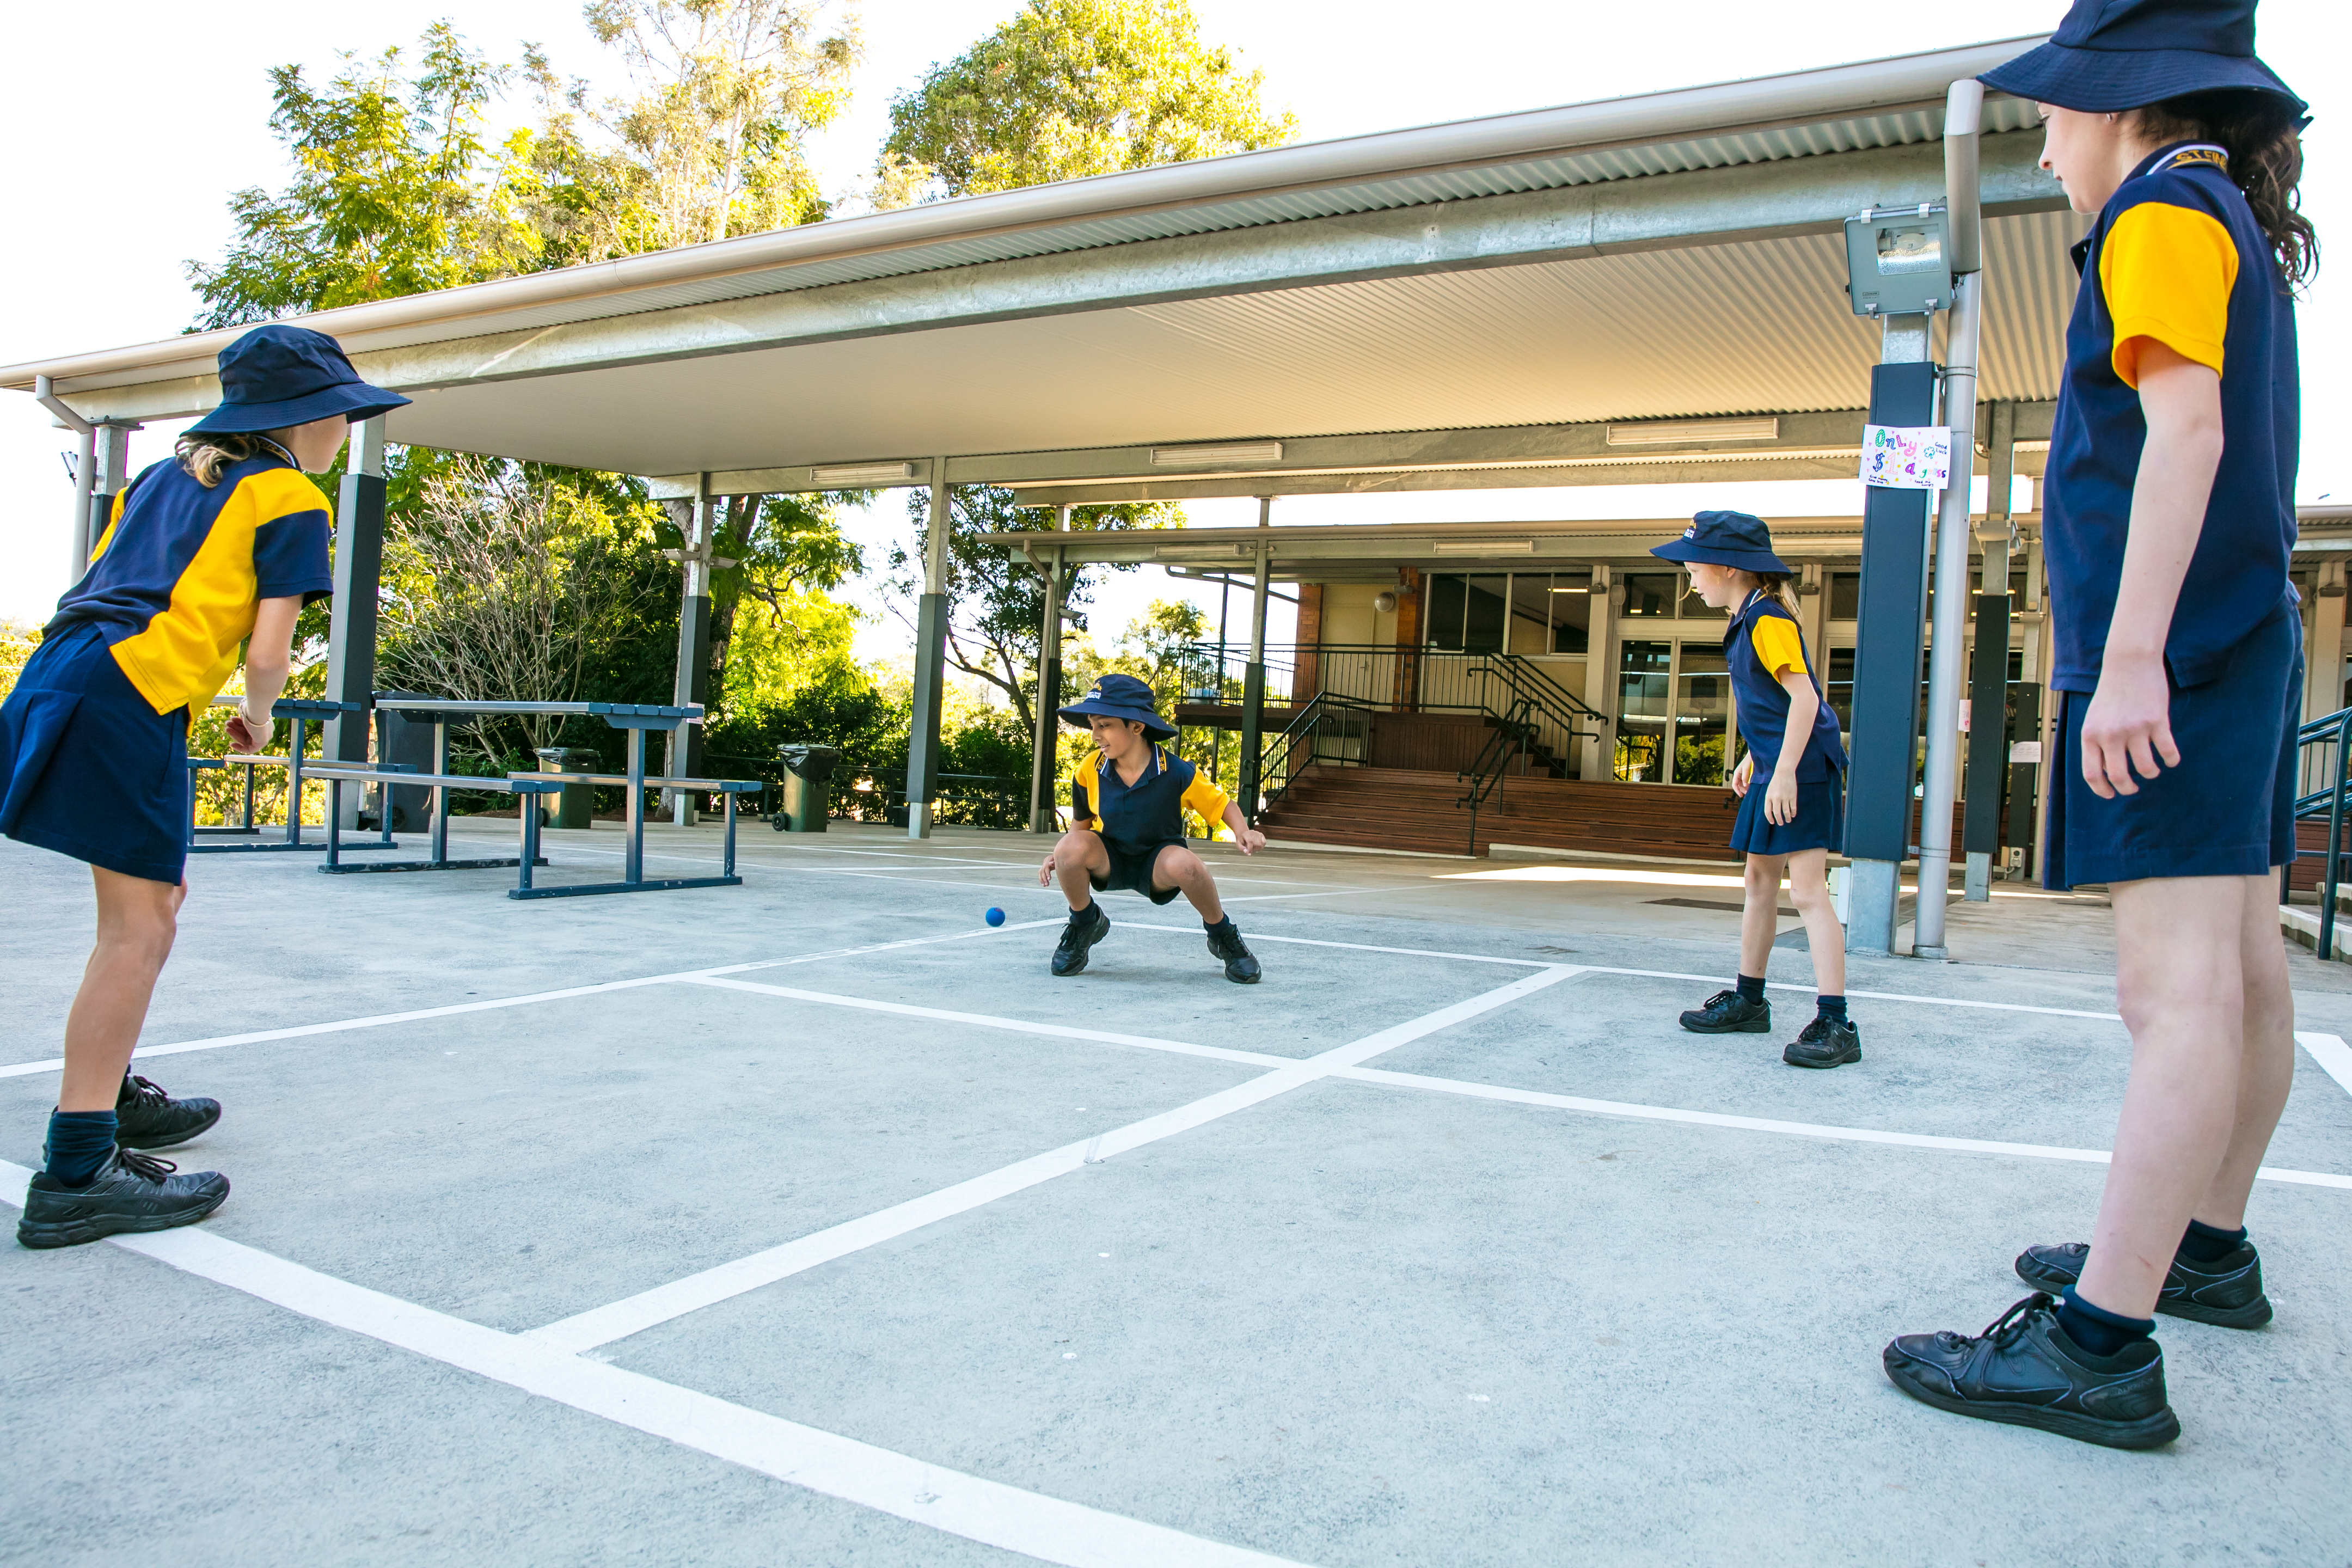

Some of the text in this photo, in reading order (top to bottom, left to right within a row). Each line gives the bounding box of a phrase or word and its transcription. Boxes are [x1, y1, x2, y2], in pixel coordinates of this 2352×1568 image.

[1935, 442, 1947, 450] Good
[1872, 452, 1898, 475] $1
[1905, 462, 1915, 475] a
